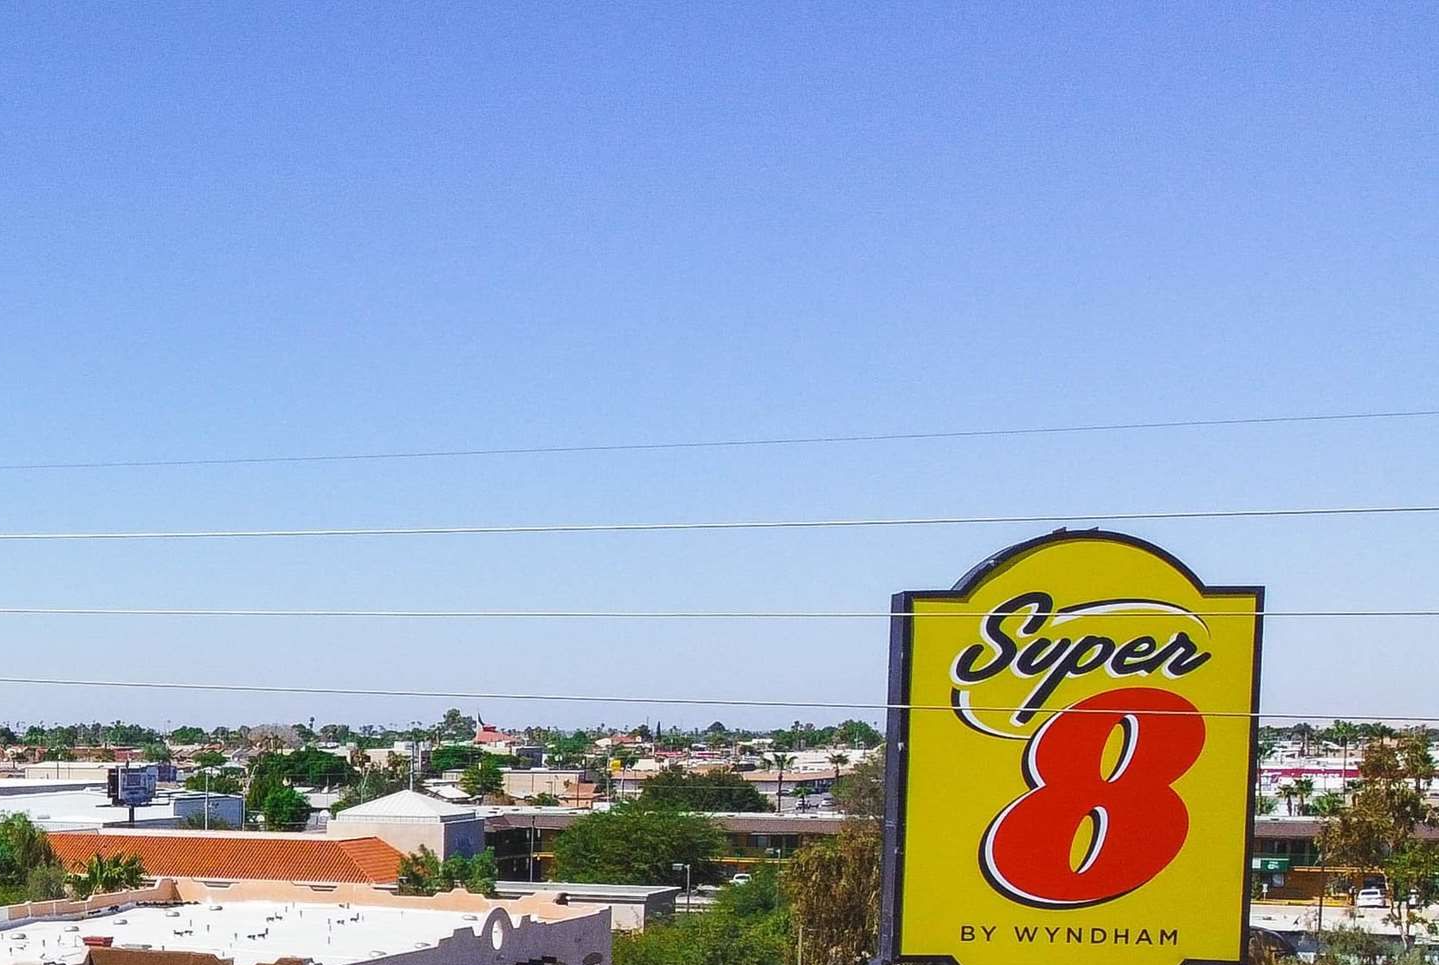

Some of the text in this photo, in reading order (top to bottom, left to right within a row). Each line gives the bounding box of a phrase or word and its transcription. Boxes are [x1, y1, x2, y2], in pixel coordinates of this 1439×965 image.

[950, 591, 1212, 727] Super
[977, 686, 1207, 911] 8
[960, 925, 1180, 946] BY WYNDHAM
